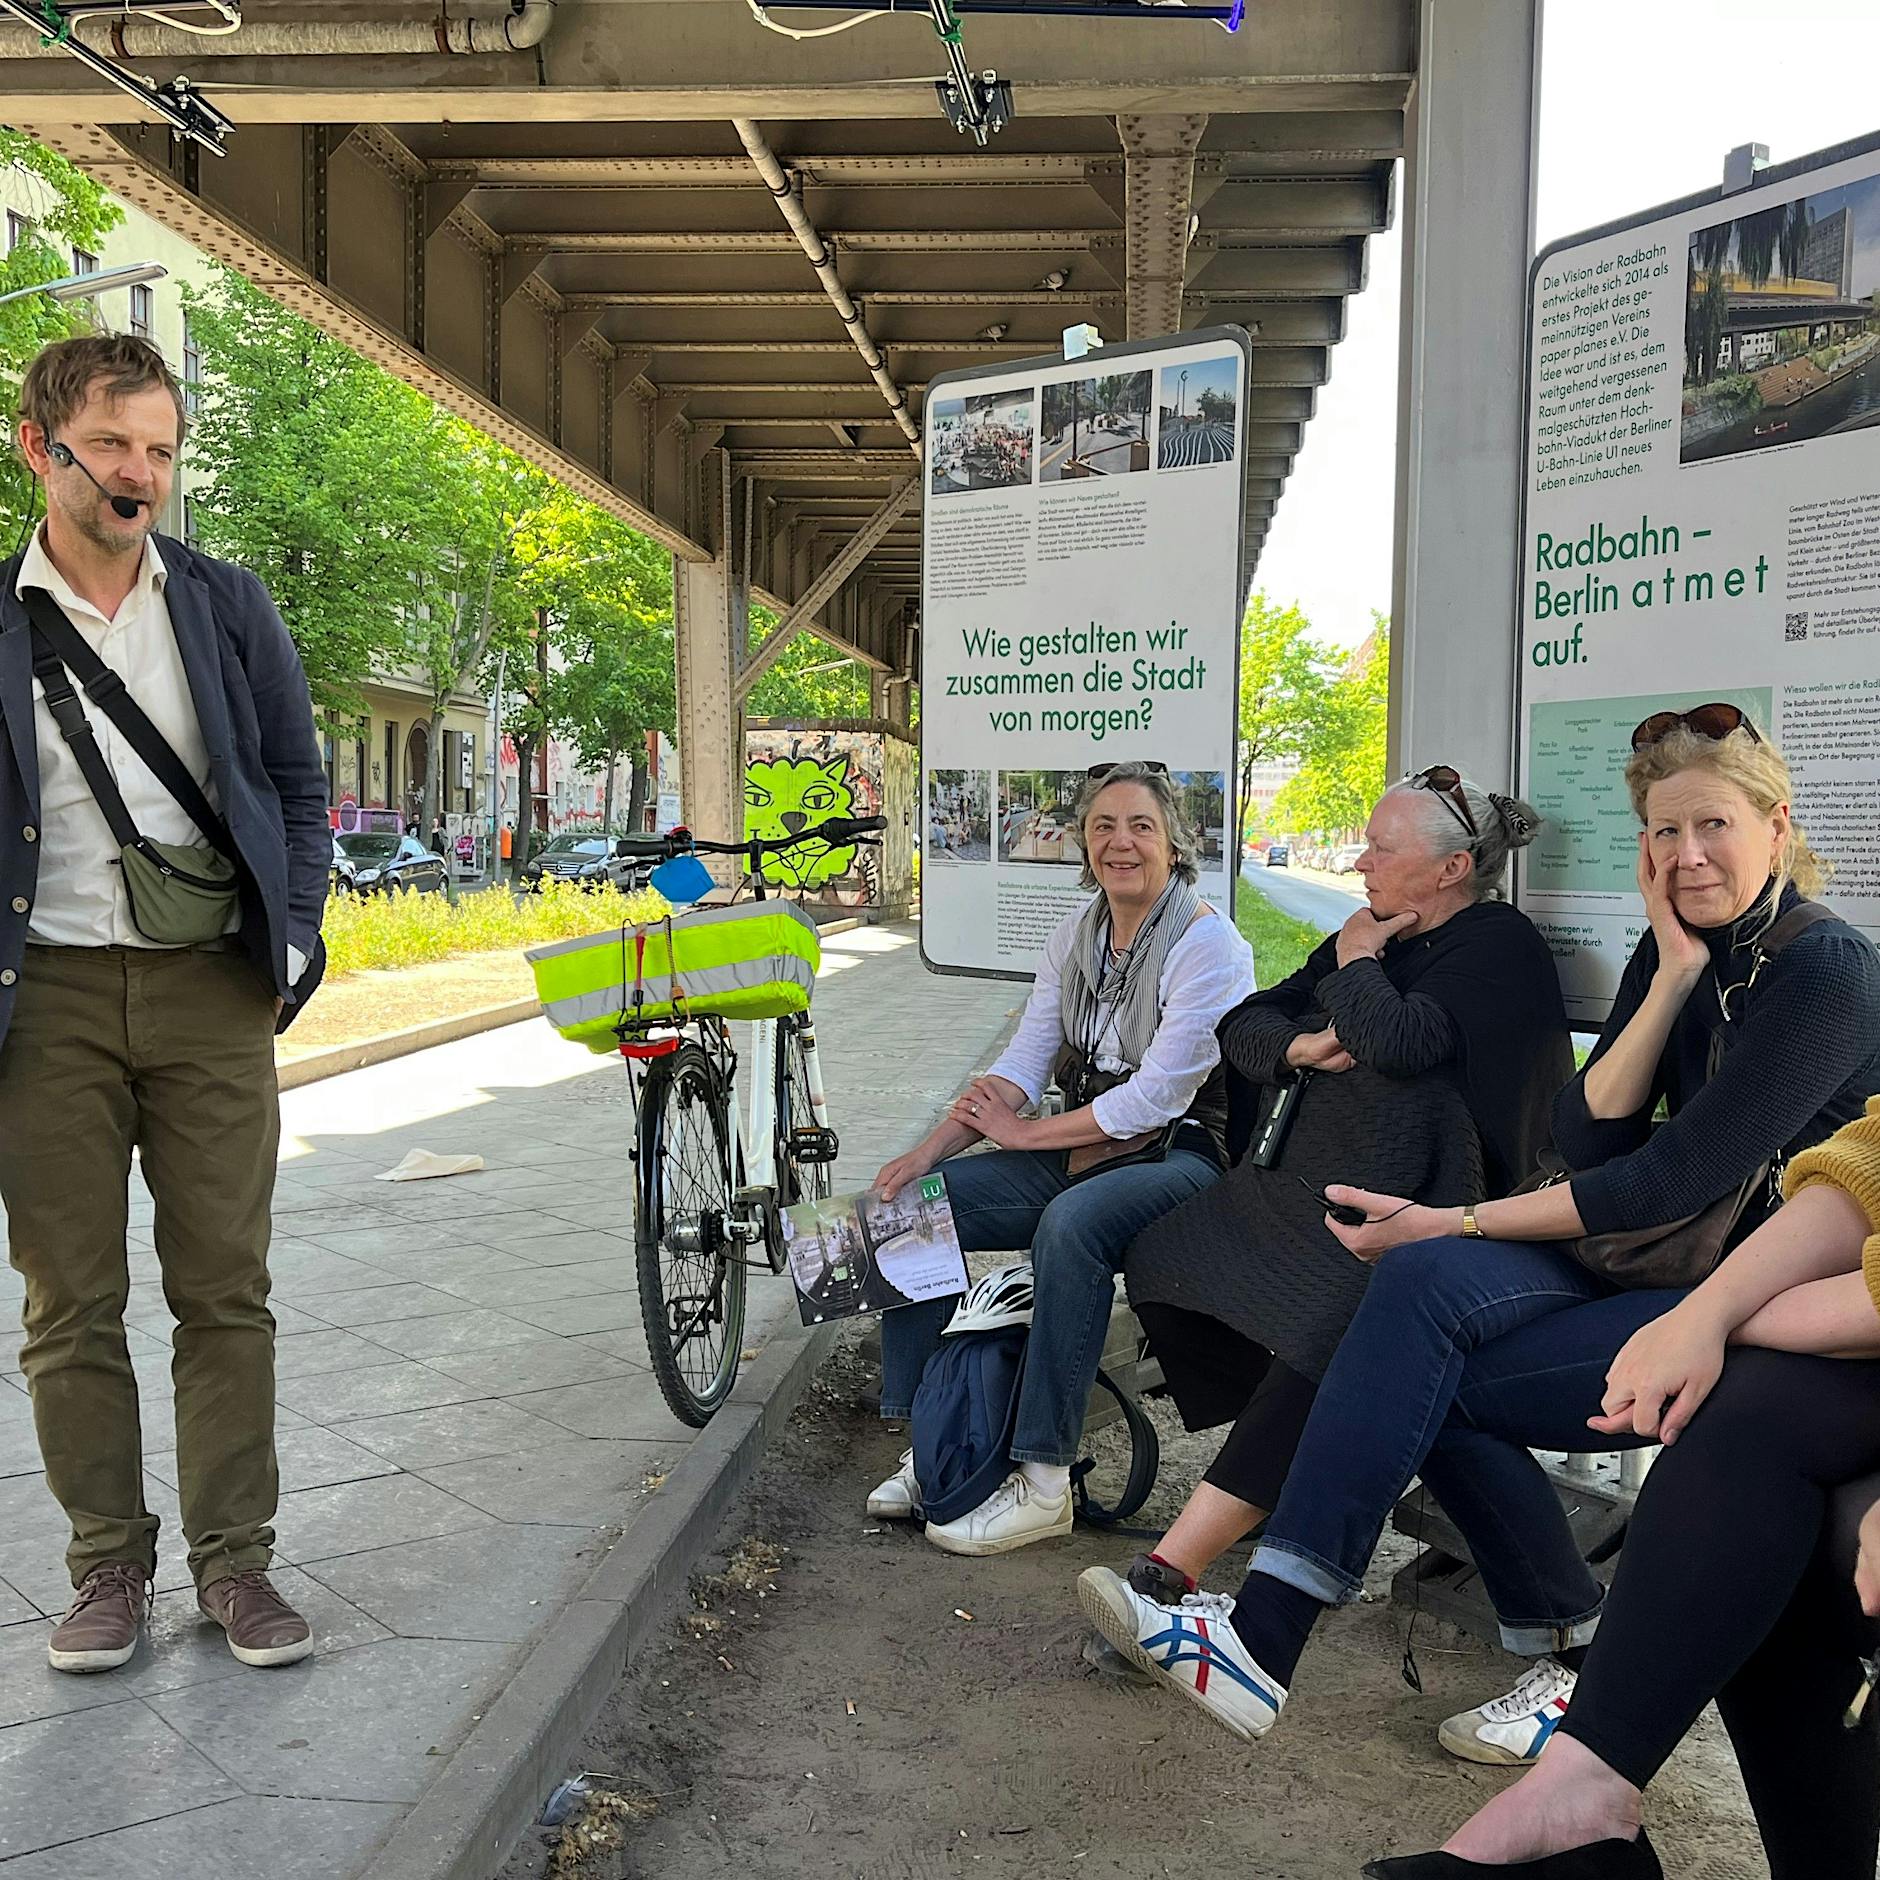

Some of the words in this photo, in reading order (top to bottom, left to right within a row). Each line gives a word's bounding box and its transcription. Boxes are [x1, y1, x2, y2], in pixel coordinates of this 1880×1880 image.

[1544, 277, 1560, 291] Die
[1563, 268, 1593, 284] Vision
[1596, 260, 1614, 275] der
[1617, 245, 1666, 269] Radbahn
[1543, 283, 1599, 309] entwickelte
[1602, 275, 1621, 292] sich
[1625, 267, 1650, 286] 2014
[1653, 262, 1668, 277] als
[1542, 312, 1570, 327] erstes
[1574, 298, 1609, 319] Projekt
[1612, 294, 1630, 308] des
[1633, 290, 1652, 306] ge-
[1541, 320, 1608, 345] meinnützigen
[1612, 308, 1650, 326] Vereins
[1541, 349, 1571, 368] paper
[1574, 339, 1607, 360] planes
[1611, 330, 1628, 346] e.V.
[1632, 326, 1649, 341] Die
[1541, 368, 1562, 381] Idee
[1565, 363, 1584, 375] war
[1587, 354, 1606, 371] und
[1610, 352, 1621, 365] ist
[1624, 351, 1638, 361] es,
[1641, 343, 1665, 357] dem
[1539, 374, 1598, 400] weitgehend
[1601, 362, 1667, 386] vergessenen
[1539, 405, 1566, 418] Raum
[1570, 398, 1595, 412] unter
[1598, 391, 1621, 405] dem
[1624, 382, 1655, 399] denk-
[1538, 412, 1617, 437] malgeschützten
[1621, 402, 1653, 419] Hoch-
[1538, 430, 1607, 455] bahn-Viadukt
[1609, 426, 1627, 440] der
[1631, 419, 1672, 436] Berliner
[1537, 450, 1603, 473] U-Bahn-Linie
[1606, 445, 1618, 460] U1
[1621, 442, 1652, 457] neues
[1537, 477, 1566, 492] Leben
[1569, 463, 1643, 485] einzuhauchen.
[1830, 498, 1846, 506] Wind
[1817, 520, 1842, 531] Bahnhof
[1843, 519, 1854, 527] Zoo
[1851, 529, 1861, 537] der
[1863, 527, 1879, 535] Stadt
[1537, 515, 1679, 572] Radbahn
[1800, 547, 1814, 555] Klein
[1815, 555, 1831, 564] durch
[1845, 552, 1868, 560] Berliner
[1846, 561, 1873, 570] Radbahn
[1535, 573, 1618, 620] Berlin
[1806, 589, 1823, 598] durch
[1834, 586, 1850, 594] Stadt
[962, 628, 1011, 658] Wie
[1019, 621, 1136, 666] gestalten
[1146, 621, 1188, 651] wir
[1532, 622, 1587, 667] auf.
[946, 673, 1073, 695] zusammen
[1083, 660, 1123, 692] die
[1132, 656, 1206, 691] Stadt
[1784, 685, 1807, 694] Wieso
[1809, 683, 1833, 692] wollen
[1849, 681, 1861, 690] die
[1794, 699, 1819, 707] Radbahn
[1832, 708, 1842, 716] soll
[989, 712, 1031, 732] von
[1042, 698, 1153, 741] morgen?
[1783, 723, 1810, 731] portieren,
[1839, 731, 1872, 739] generieren.
[1835, 740, 1871, 748] Miteinander
[1819, 753, 1829, 761] Ort
[1842, 752, 1875, 761] Begegnung
[1804, 781, 1832, 789] entspricht
[1802, 791, 1830, 800] vielfältige
[1831, 791, 1863, 800] Nutzungen
[1859, 855, 1874, 864] nach
[1875, 857, 1880, 865] B
[1859, 868, 1870, 876] der
[1548, 923, 1581, 936] bewegen
[1582, 926, 1593, 934] wir
[1625, 928, 1640, 936] Wie
[1582, 939, 1603, 947] durch
[922, 1184, 940, 1198] U1
